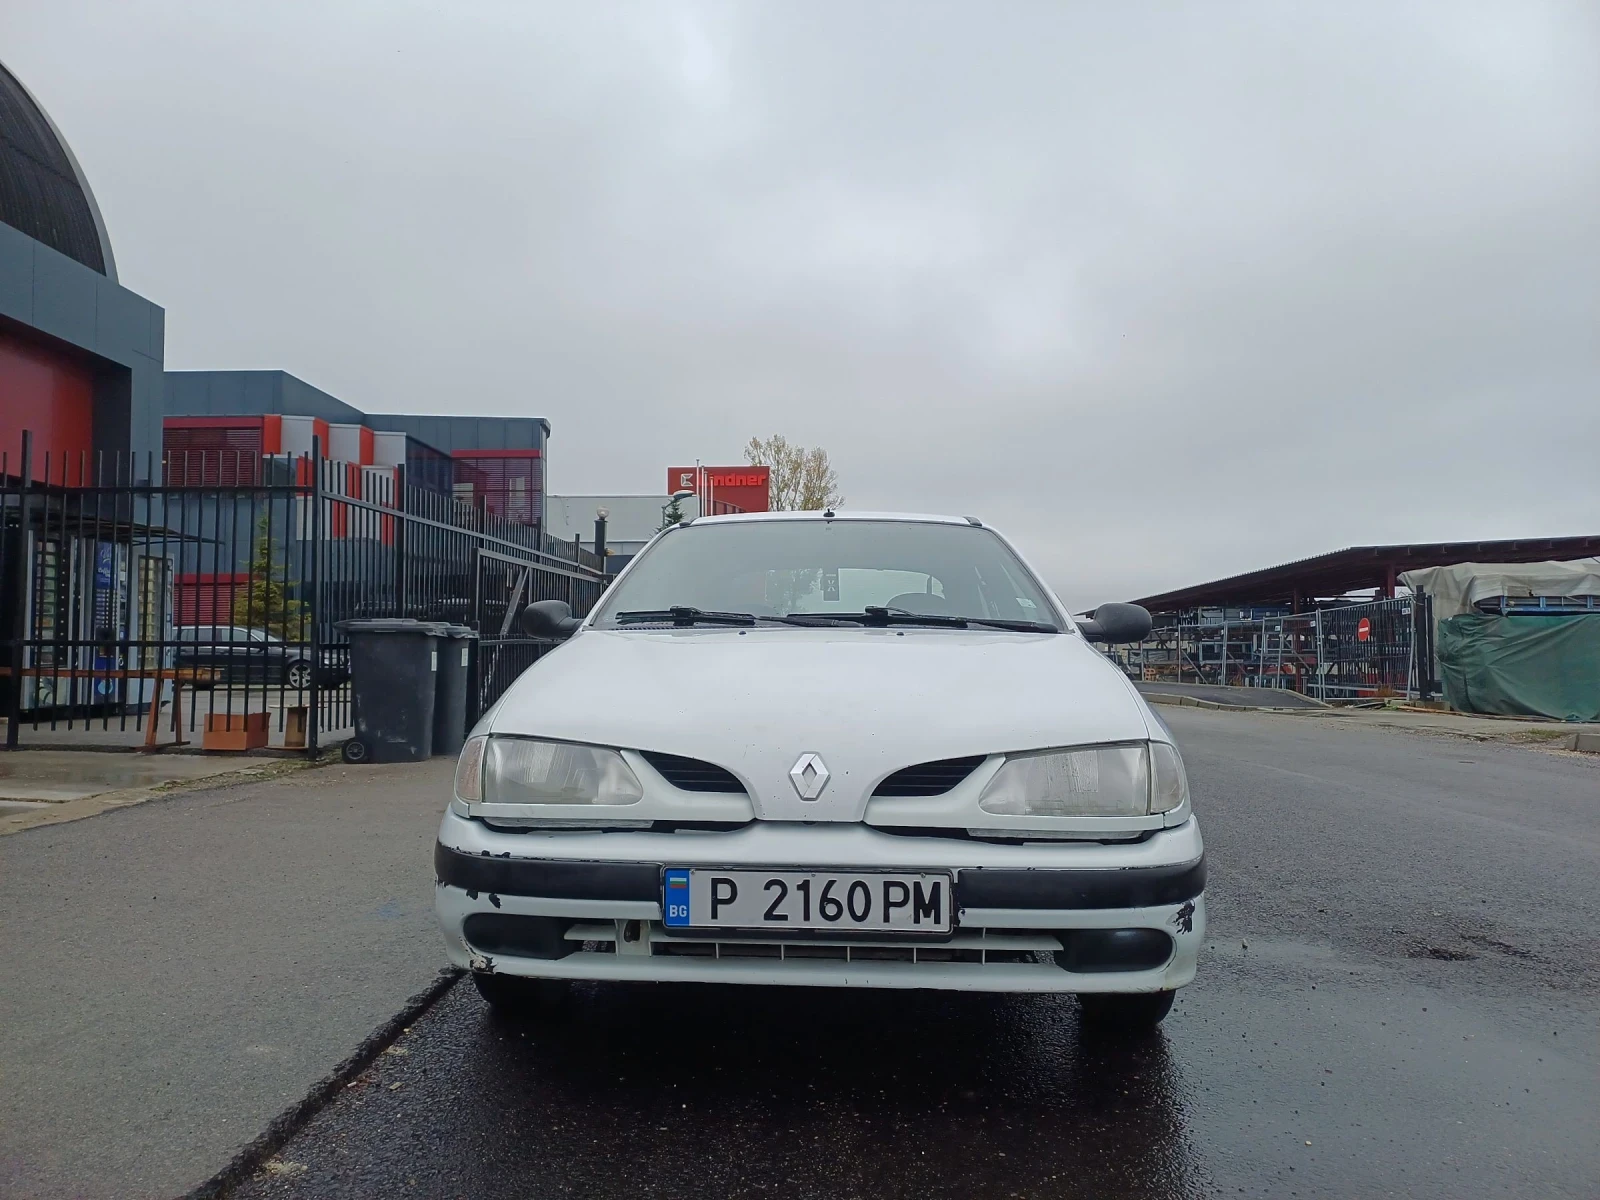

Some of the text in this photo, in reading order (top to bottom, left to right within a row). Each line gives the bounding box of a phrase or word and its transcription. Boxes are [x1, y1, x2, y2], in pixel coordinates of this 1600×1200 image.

[669, 904, 688, 918] BG
[710, 877, 941, 924] P 2160 PM
